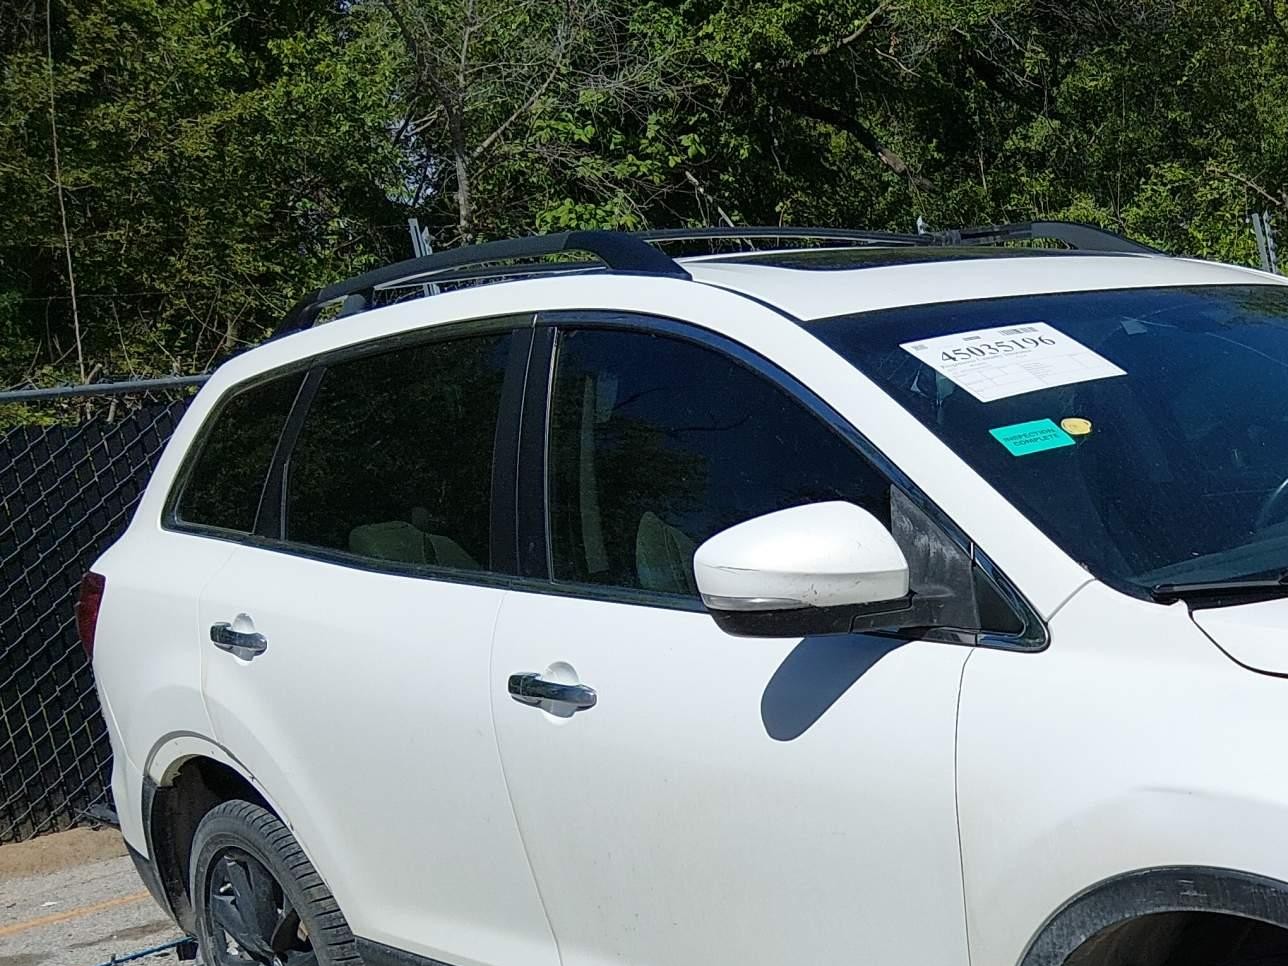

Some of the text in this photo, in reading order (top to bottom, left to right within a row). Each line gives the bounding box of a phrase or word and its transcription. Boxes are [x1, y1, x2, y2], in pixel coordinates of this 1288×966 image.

[940, 336, 1056, 361] 45035196
[1002, 427, 1056, 443] INSPECTION
[1013, 432, 1060, 447] COMPLETE
